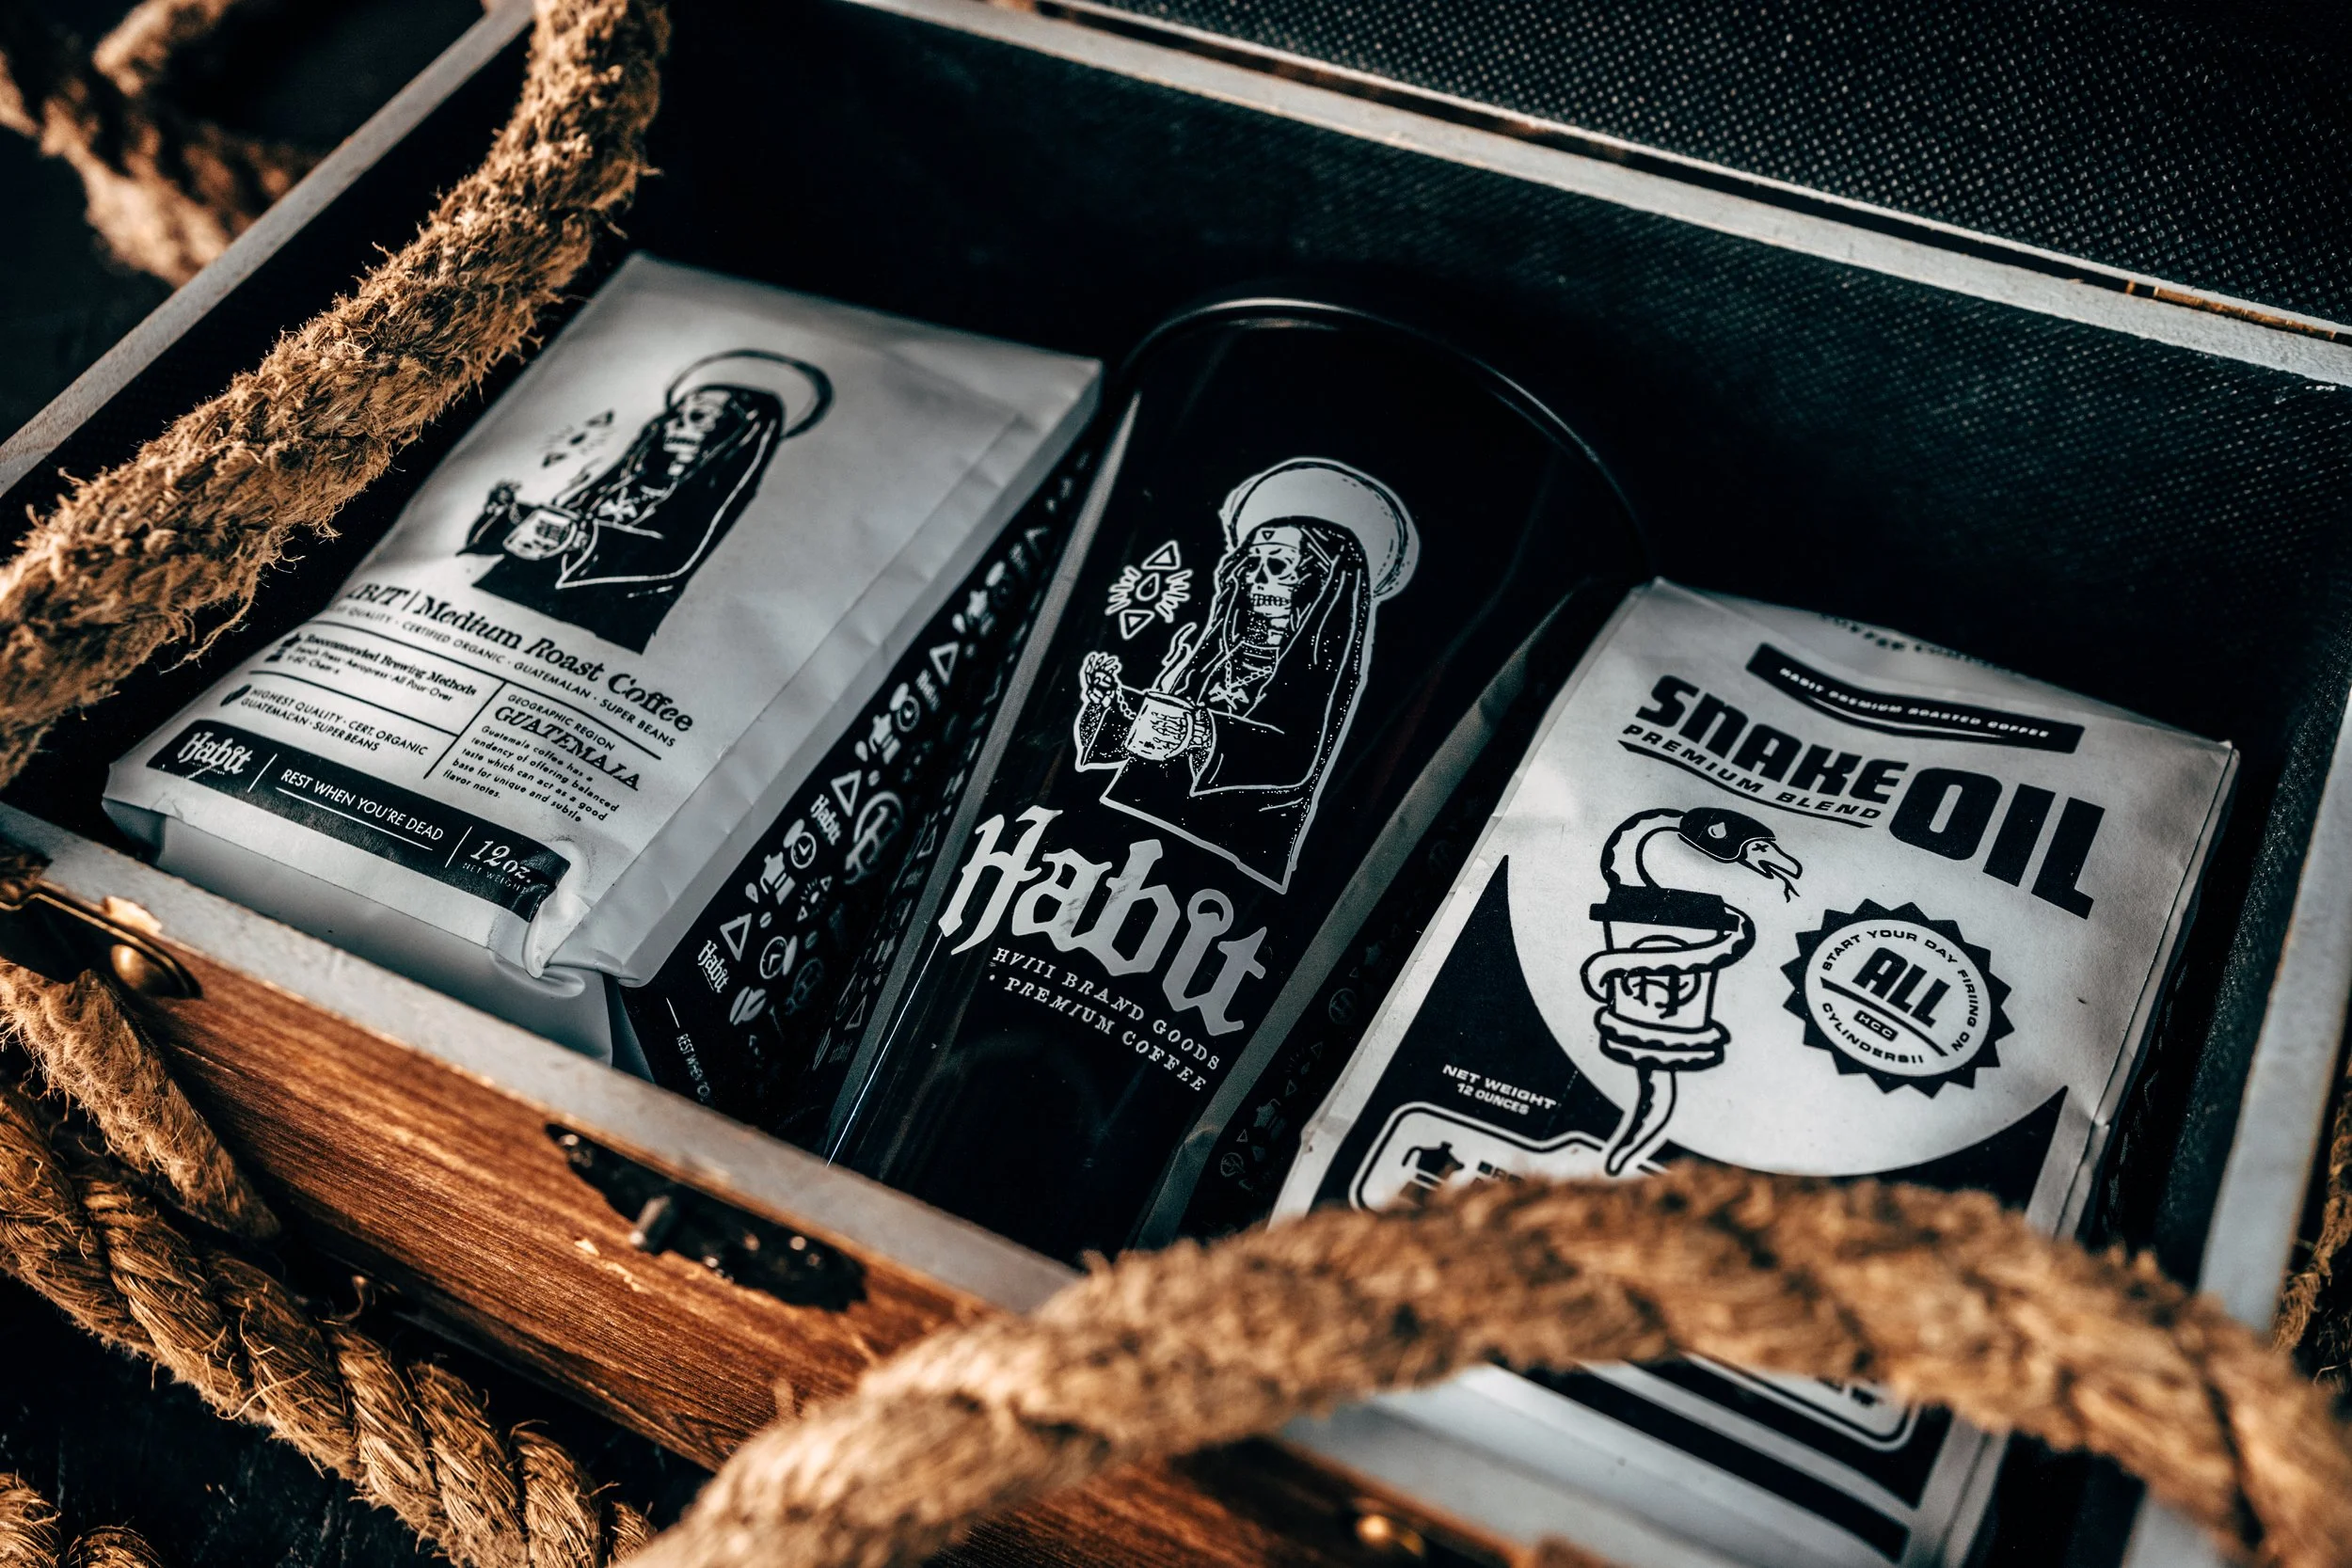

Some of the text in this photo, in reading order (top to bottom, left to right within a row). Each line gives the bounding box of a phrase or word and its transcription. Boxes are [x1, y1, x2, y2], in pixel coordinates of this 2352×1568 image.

[304, 633, 477, 696] Recommended Brewing Methods
[348, 606, 676, 748] QUALITY CERTIFIED ORGANIC GUATEMALAN SUPER BEANS
[391, 674, 406, 685] All
[413, 594, 522, 650] Medium
[524, 638, 605, 682] Roast
[608, 673, 693, 732] Coffee
[240, 697, 380, 752] GUATEMALAN SUPER BEANS
[250, 688, 429, 756] HIGHEST QUALITY CERT. ORGANIC
[508, 694, 615, 751] GEOGRAPHIC REGION
[1779, 667, 2050, 738] HABIT PREMIUM ROASTED COFFEE
[177, 731, 253, 775] Habit
[471, 736, 515, 758] tendency
[530, 758, 569, 784] offering
[571, 780, 619, 813] balanced
[481, 725, 531, 749] Guatemala
[532, 745, 564, 766] coffee
[566, 763, 583, 778] has
[494, 705, 641, 791] GUATEMALA
[1622, 723, 1882, 819] PREMIUM BLEND
[280, 768, 444, 841] REST WHEN YOU'RE DEAD
[443, 768, 501, 799] flavor notes.
[452, 758, 582, 823] base for unique and subtle
[462, 748, 484, 762] taste
[487, 756, 515, 773] which
[516, 768, 534, 782] can
[536, 779, 554, 790] act
[555, 787, 567, 798] as
[578, 800, 609, 822] good
[1889, 767, 2106, 920] OIL
[462, 863, 527, 894] NET WEIGHT
[938, 805, 1267, 1036] Habit
[697, 940, 729, 993] Habit
[1821, 934, 1861, 972] START
[1867, 929, 1918, 942] YOUR
[1924, 939, 1958, 964] DAY
[1950, 1031, 1970, 1052] ON
[1851, 946, 1951, 1029] ALL
[993, 946, 1220, 1070] HVIII BRAND GOODS
[1004, 976, 1207, 1091] PREMIUM COFFEE
[1858, 1014, 1893, 1038] HCC
[676, 1033, 694, 1054] REST
[1442, 1064, 1557, 1110] NET WEIGHT
[1456, 1082, 1530, 1116] 12 OUNCES
